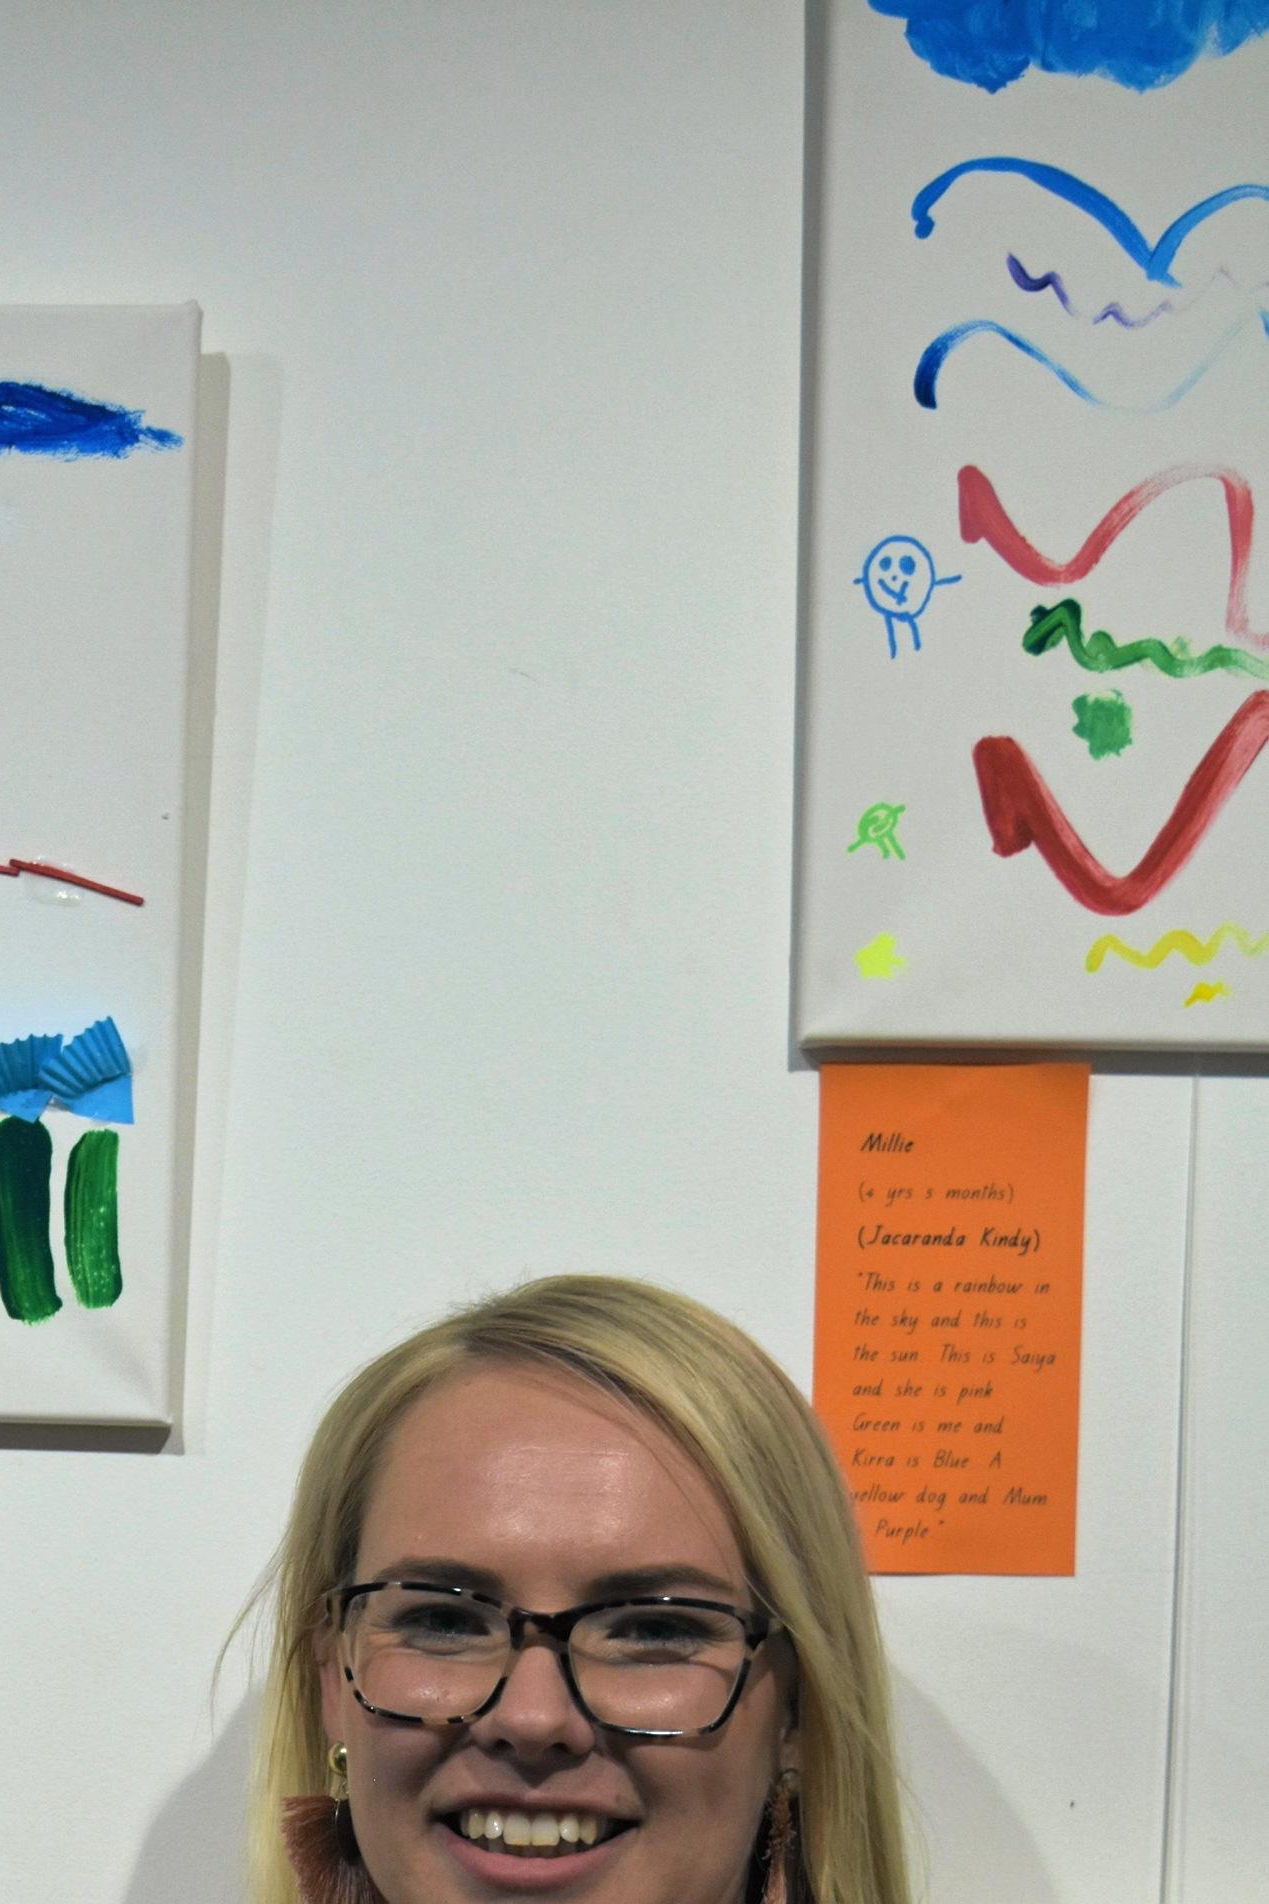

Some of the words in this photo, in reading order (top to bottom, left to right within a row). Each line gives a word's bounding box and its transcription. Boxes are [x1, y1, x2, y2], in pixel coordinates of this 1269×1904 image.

[860, 1132, 915, 1153] Millie
[886, 1186, 914, 1207] yrs
[946, 1182, 1014, 1204] months)
[858, 1224, 966, 1248] (Jacaranda
[980, 1226, 1041, 1256] Kindy)
[907, 1277, 921, 1292] is
[934, 1280, 943, 1292] a
[954, 1274, 1023, 1294] rainbow
[1035, 1281, 1050, 1294] in
[853, 1309, 880, 1326] the
[891, 1309, 919, 1335] sky
[931, 1310, 962, 1328] and
[973, 1311, 1003, 1329] this
[1014, 1316, 1027, 1329] is
[853, 1344, 879, 1361] the
[940, 1343, 972, 1363] This
[982, 1350, 995, 1363] is
[1011, 1345, 1057, 1373] Saiya
[852, 1379, 883, 1397] and
[895, 1379, 923, 1397] she
[934, 1385, 947, 1397] is
[852, 1412, 901, 1431] Green
[912, 1420, 924, 1432] is
[937, 1421, 962, 1433] me
[974, 1416, 1004, 1434] and
[852, 1448, 895, 1467] Kirra
[907, 1455, 920, 1468] is
[989, 1450, 1003, 1468] A
[916, 1485, 947, 1511] dog
[958, 1487, 989, 1505] and
[1003, 1487, 1049, 1506] Mum
